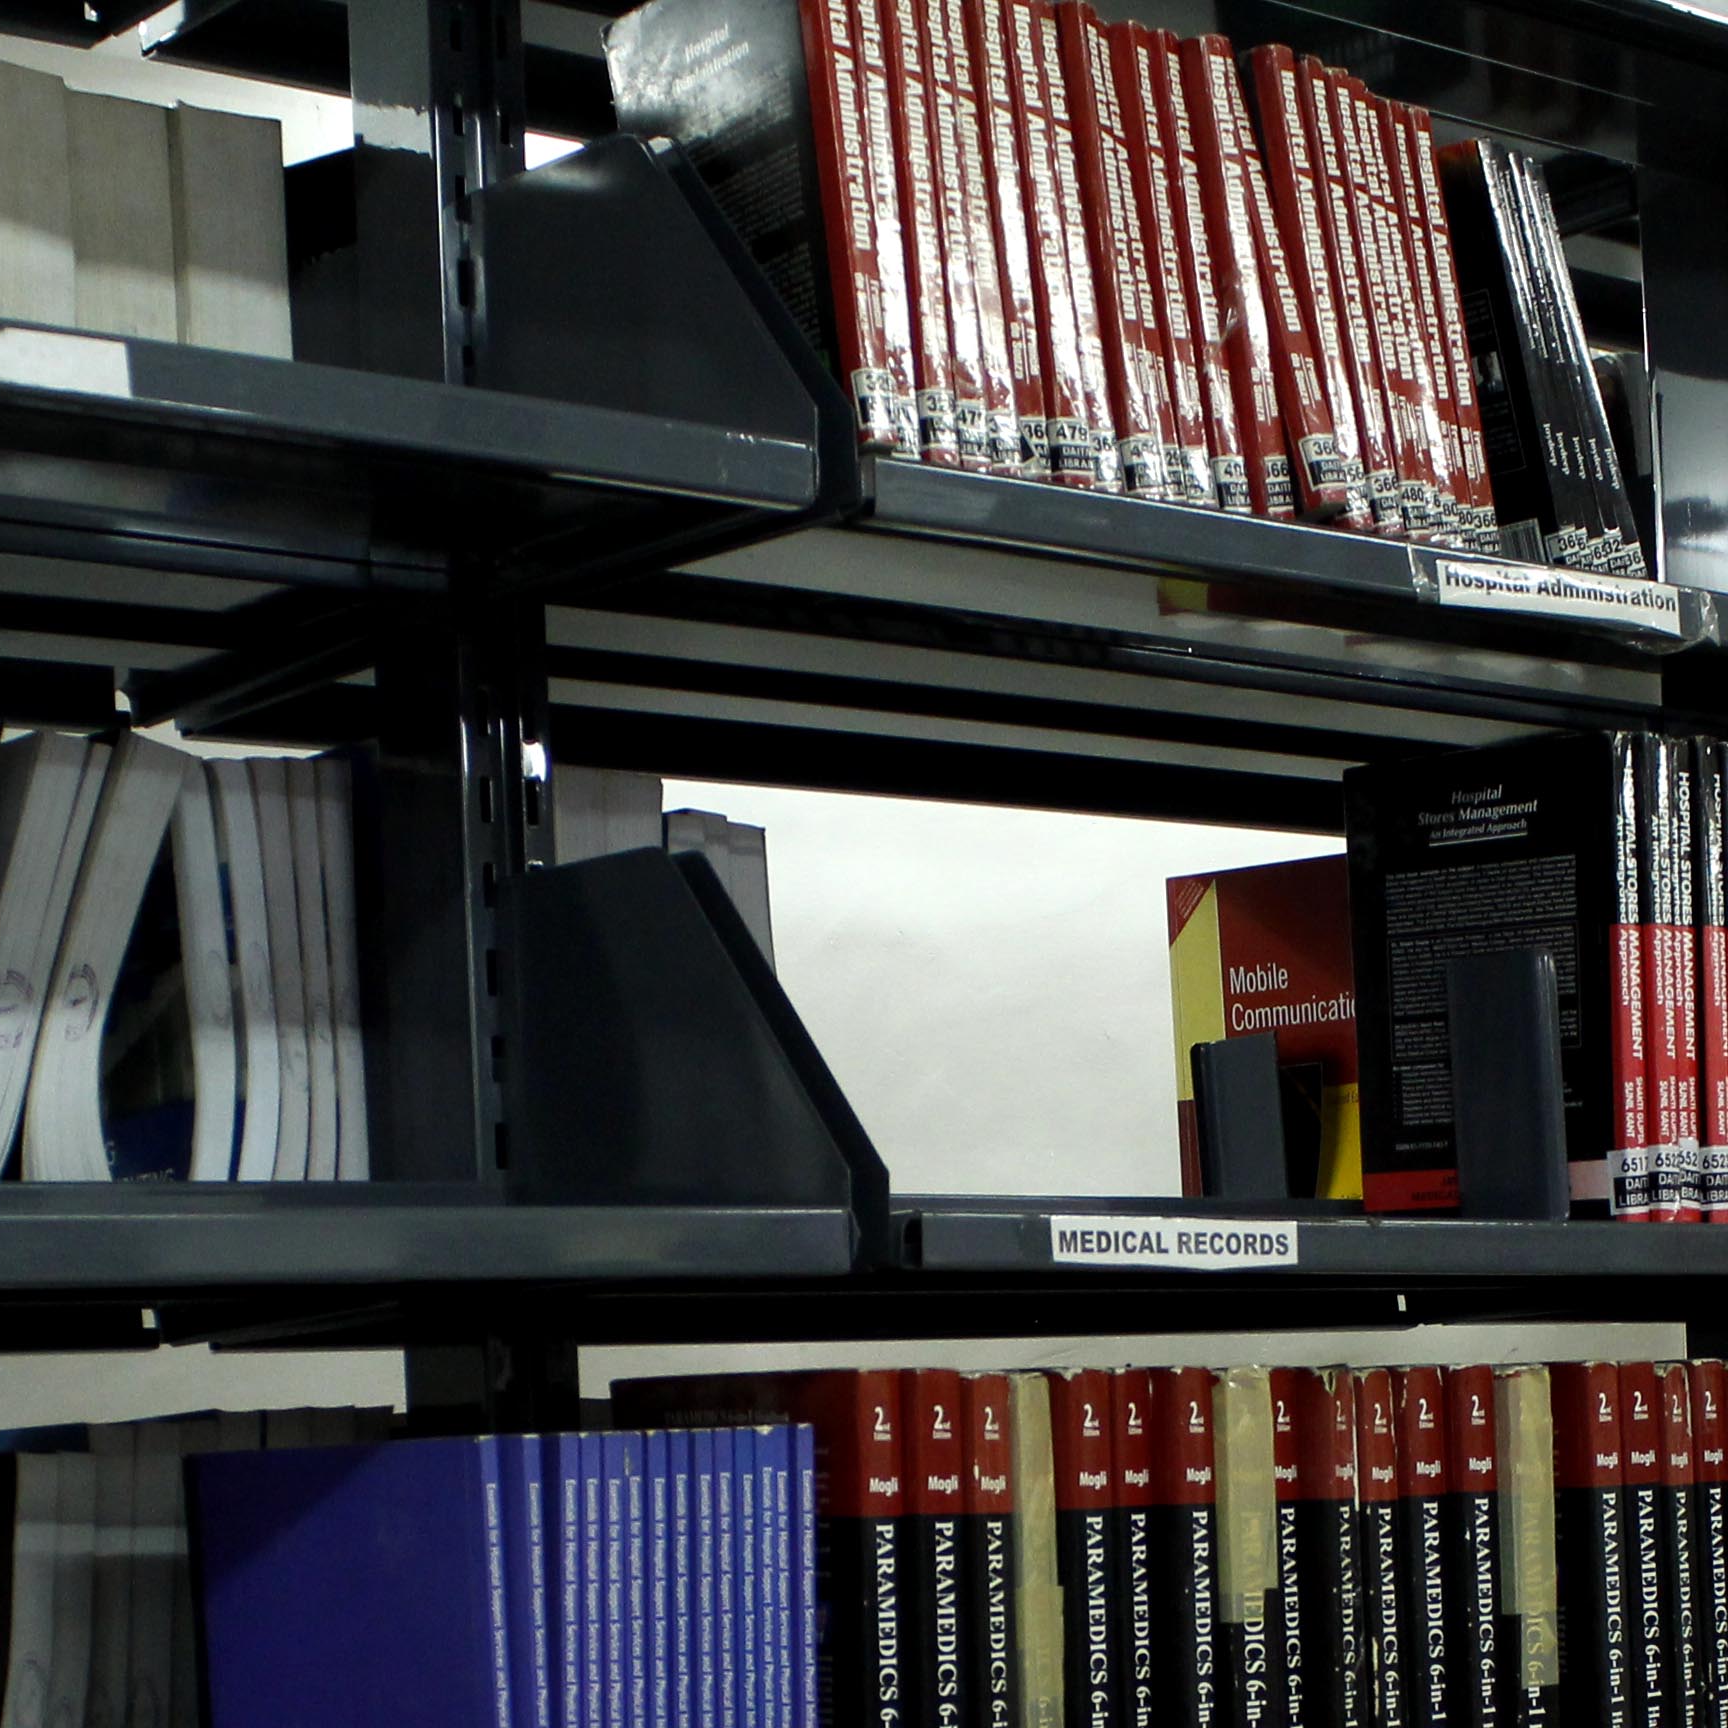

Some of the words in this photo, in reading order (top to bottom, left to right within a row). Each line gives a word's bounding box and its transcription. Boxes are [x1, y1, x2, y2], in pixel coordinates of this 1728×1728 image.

[1137, 46, 1162, 148] Hospital
[1150, 152, 1187, 338] Administration
[1281, 69, 1309, 169] Hospital
[1295, 173, 1337, 361] Administration
[1444, 564, 1532, 597] Hospital
[1537, 576, 1679, 614] Administration
[1418, 812, 1454, 825] Stores
[1459, 800, 1538, 820] Management
[1452, 785, 1502, 804] Hospital
[1230, 964, 1288, 994] Mobile
[1621, 929, 1629, 1005] Approach
[1629, 929, 1643, 1060] MANAGEMENT
[1059, 1231, 1169, 1254] MEDICAL
[1178, 1232, 1289, 1255] RECORDS
[928, 1475, 958, 1493] Mogli
[1416, 1460, 1441, 1476] Mogli
[1423, 1502, 1445, 1659] PARAMEDICS
[934, 1520, 958, 1700] PARAMEDICS
[1429, 1663, 1446, 1719] 6-in-1
